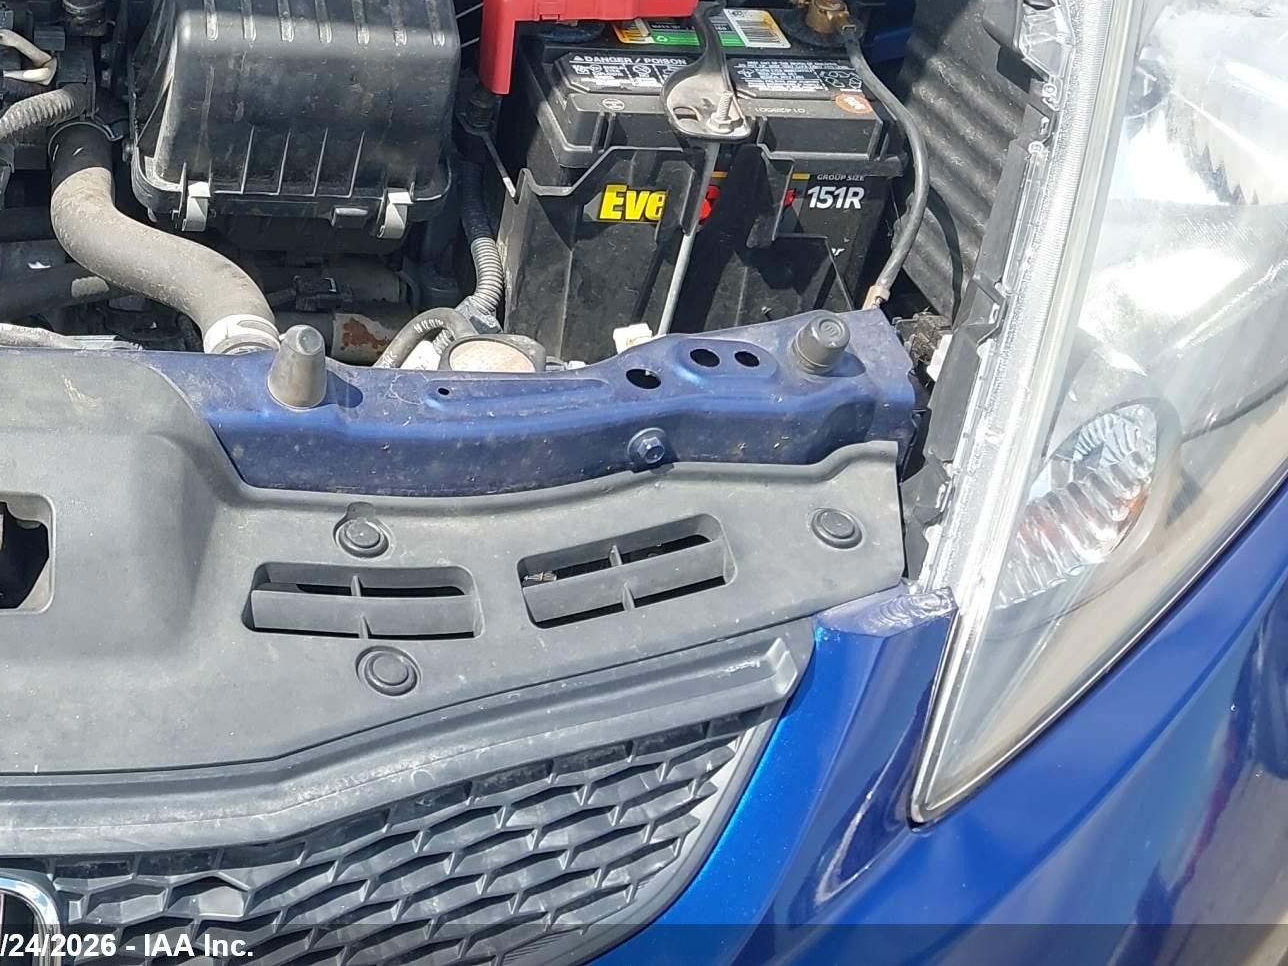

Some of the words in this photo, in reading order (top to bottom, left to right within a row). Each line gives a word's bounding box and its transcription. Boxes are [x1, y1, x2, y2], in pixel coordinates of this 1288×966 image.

[583, 55, 633, 64] DANGER
[643, 57, 688, 66] POISON
[817, 173, 846, 181] GROUP
[847, 174, 865, 182] SIZE
[807, 185, 865, 209] 151R
